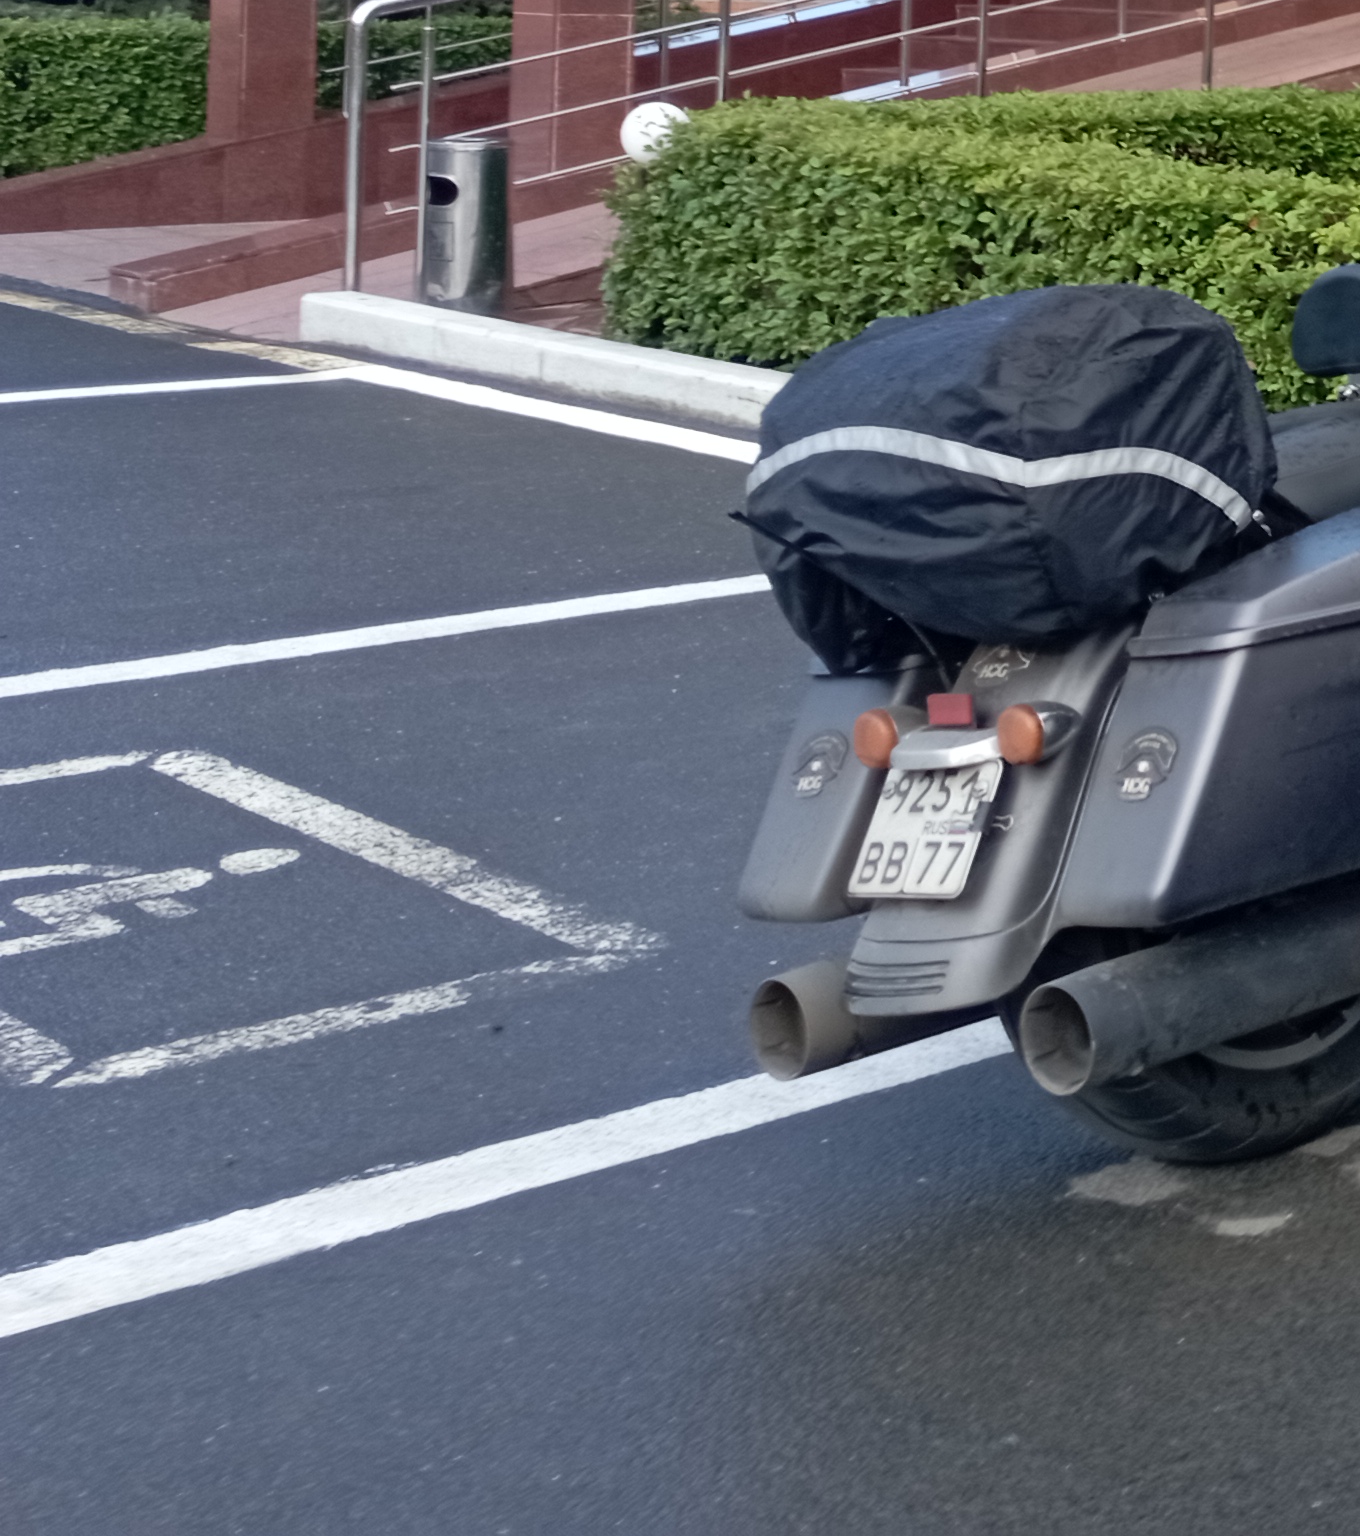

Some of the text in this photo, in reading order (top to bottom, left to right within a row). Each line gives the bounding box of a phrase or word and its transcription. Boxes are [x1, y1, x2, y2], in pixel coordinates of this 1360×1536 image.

[893, 768, 982, 815] 9251
[922, 820, 949, 835] RUS
[916, 841, 966, 885] 77
